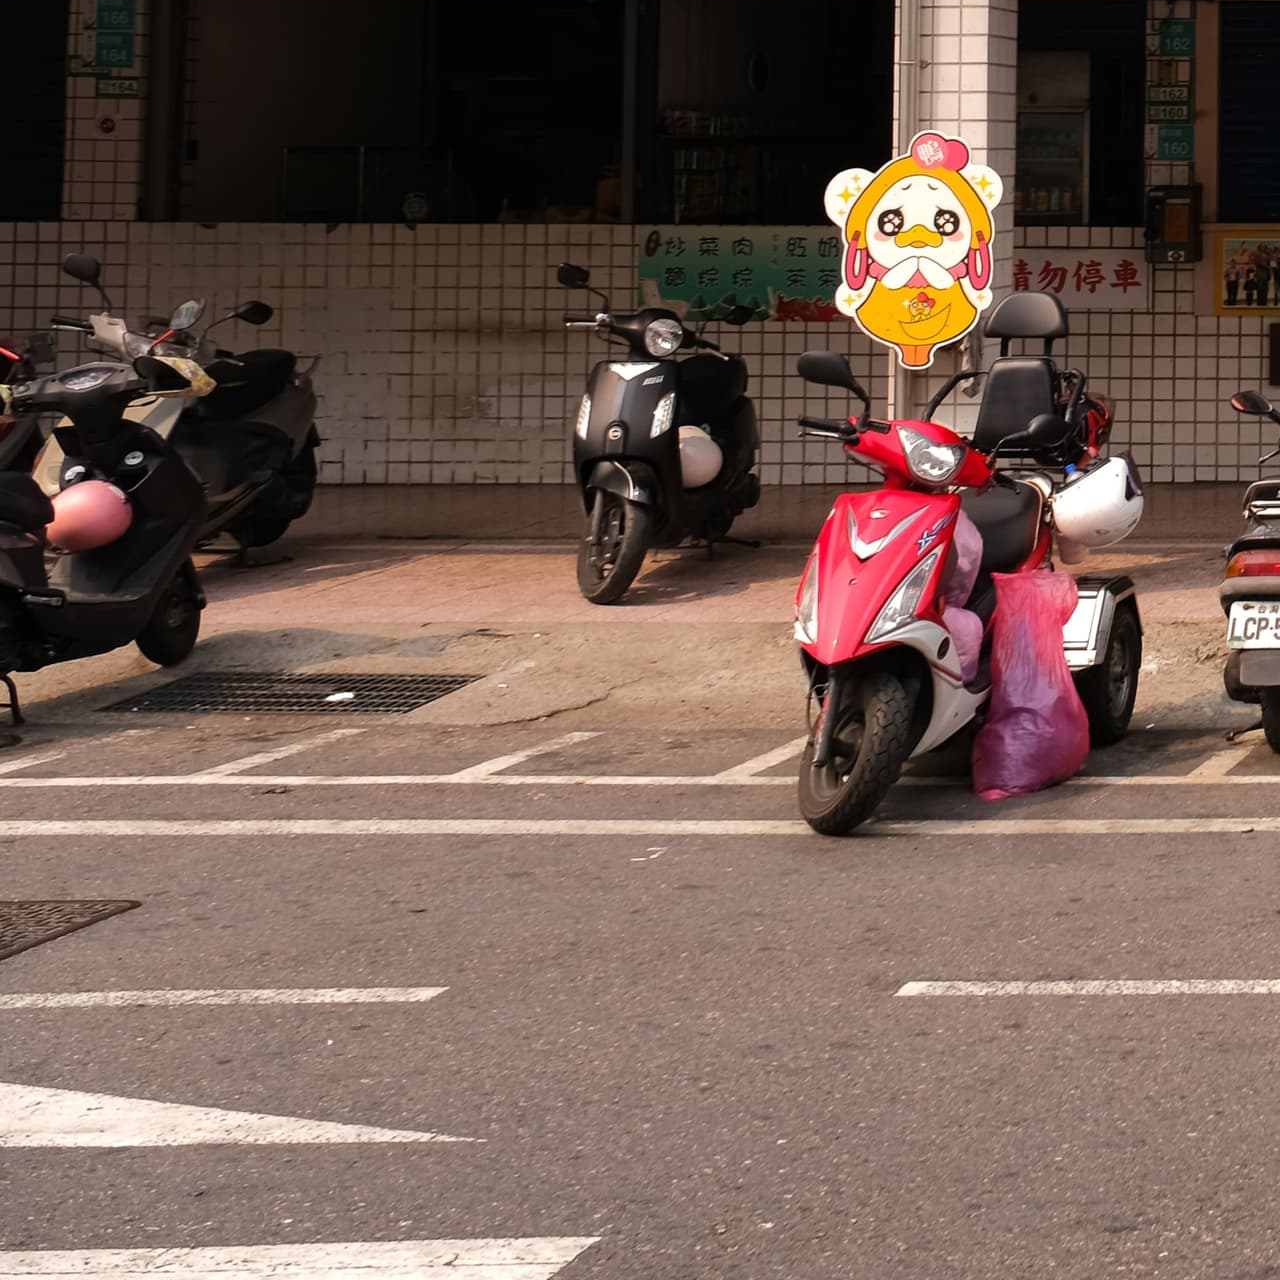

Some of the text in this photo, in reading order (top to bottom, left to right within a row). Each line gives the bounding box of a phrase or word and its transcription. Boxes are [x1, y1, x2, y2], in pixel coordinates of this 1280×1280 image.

[1165, 37, 1191, 51] 162
[1162, 88, 1185, 100] 162
[1162, 107, 1184, 119] 160
[1163, 142, 1188, 155] 160
